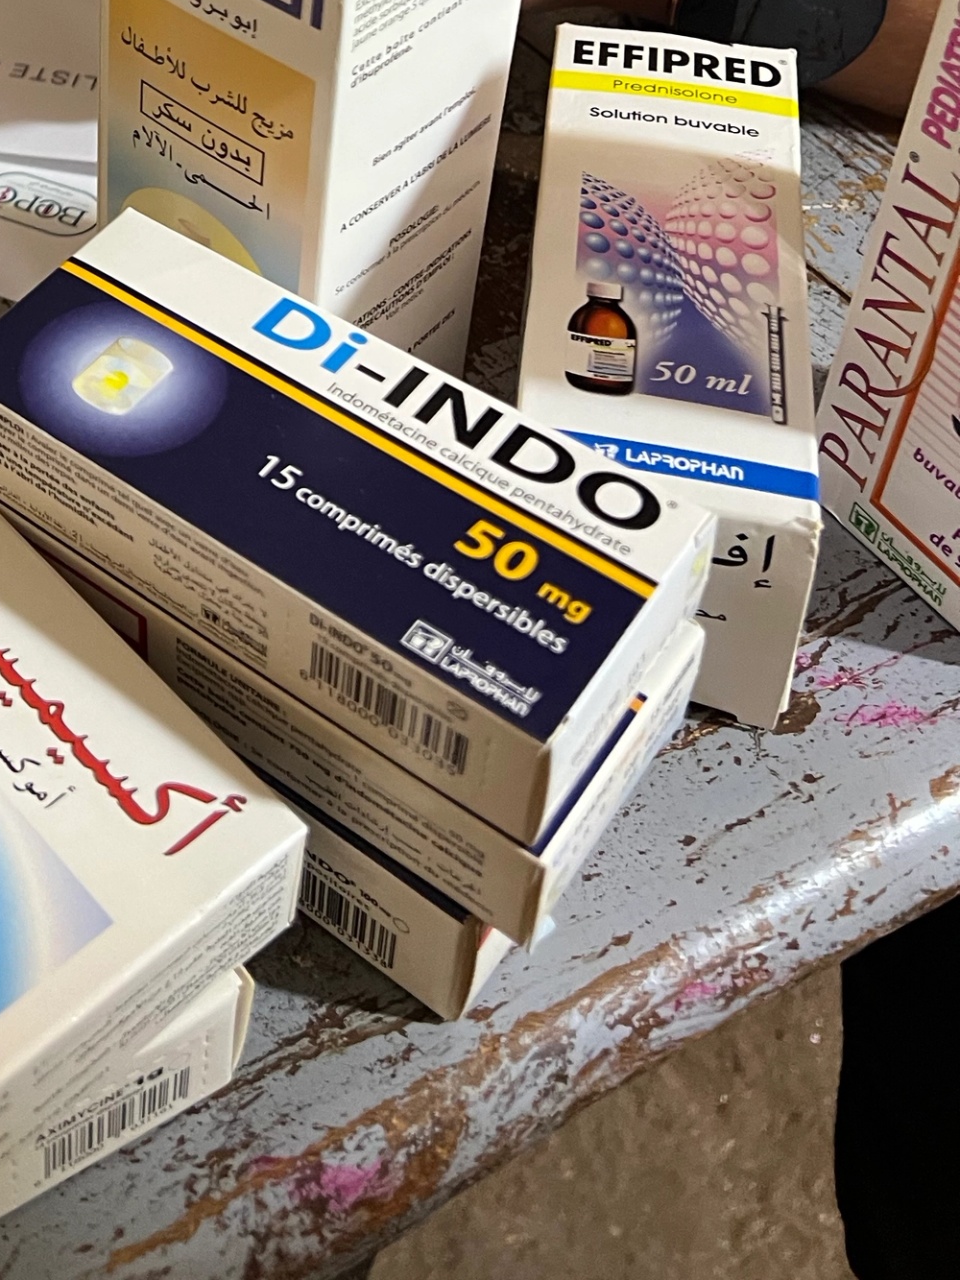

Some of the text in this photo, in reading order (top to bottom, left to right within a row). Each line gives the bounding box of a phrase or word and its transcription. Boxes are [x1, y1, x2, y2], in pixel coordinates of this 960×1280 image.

[8, 61, 98, 92] LISTE
[121, 26, 294, 142] مزيج للشرب للأطفال
[351, 50, 382, 76] Cette
[573, 39, 782, 89] EFFIPRED
[612, 79, 738, 106] Prednisolone
[152, 100, 252, 168] بدون سكر
[372, 112, 442, 166] Bien agiter avant
[589, 106, 760, 139] Solution buvable
[340, 223, 347, 233] A
[348, 186, 401, 226] CONSERVER
[436, 150, 447, 165] DE
[448, 141, 458, 156] LA
[818, 162, 960, 494] PARANTAL
[649, 360, 697, 385] 50
[705, 372, 754, 395] ml
[252, 296, 662, 531] Di-INDO
[6, 454, 22, 470] une
[326, 381, 632, 558] Indométacine calcique pentahydrate
[62, 481, 77, 496] des
[79, 492, 115, 521] enfants
[257, 452, 304, 491] 15
[294, 484, 425, 571] comprimés
[423, 561, 568, 655] dispersibles
[454, 519, 594, 625] 50 mg
[304, 860, 369, 911] positoires
